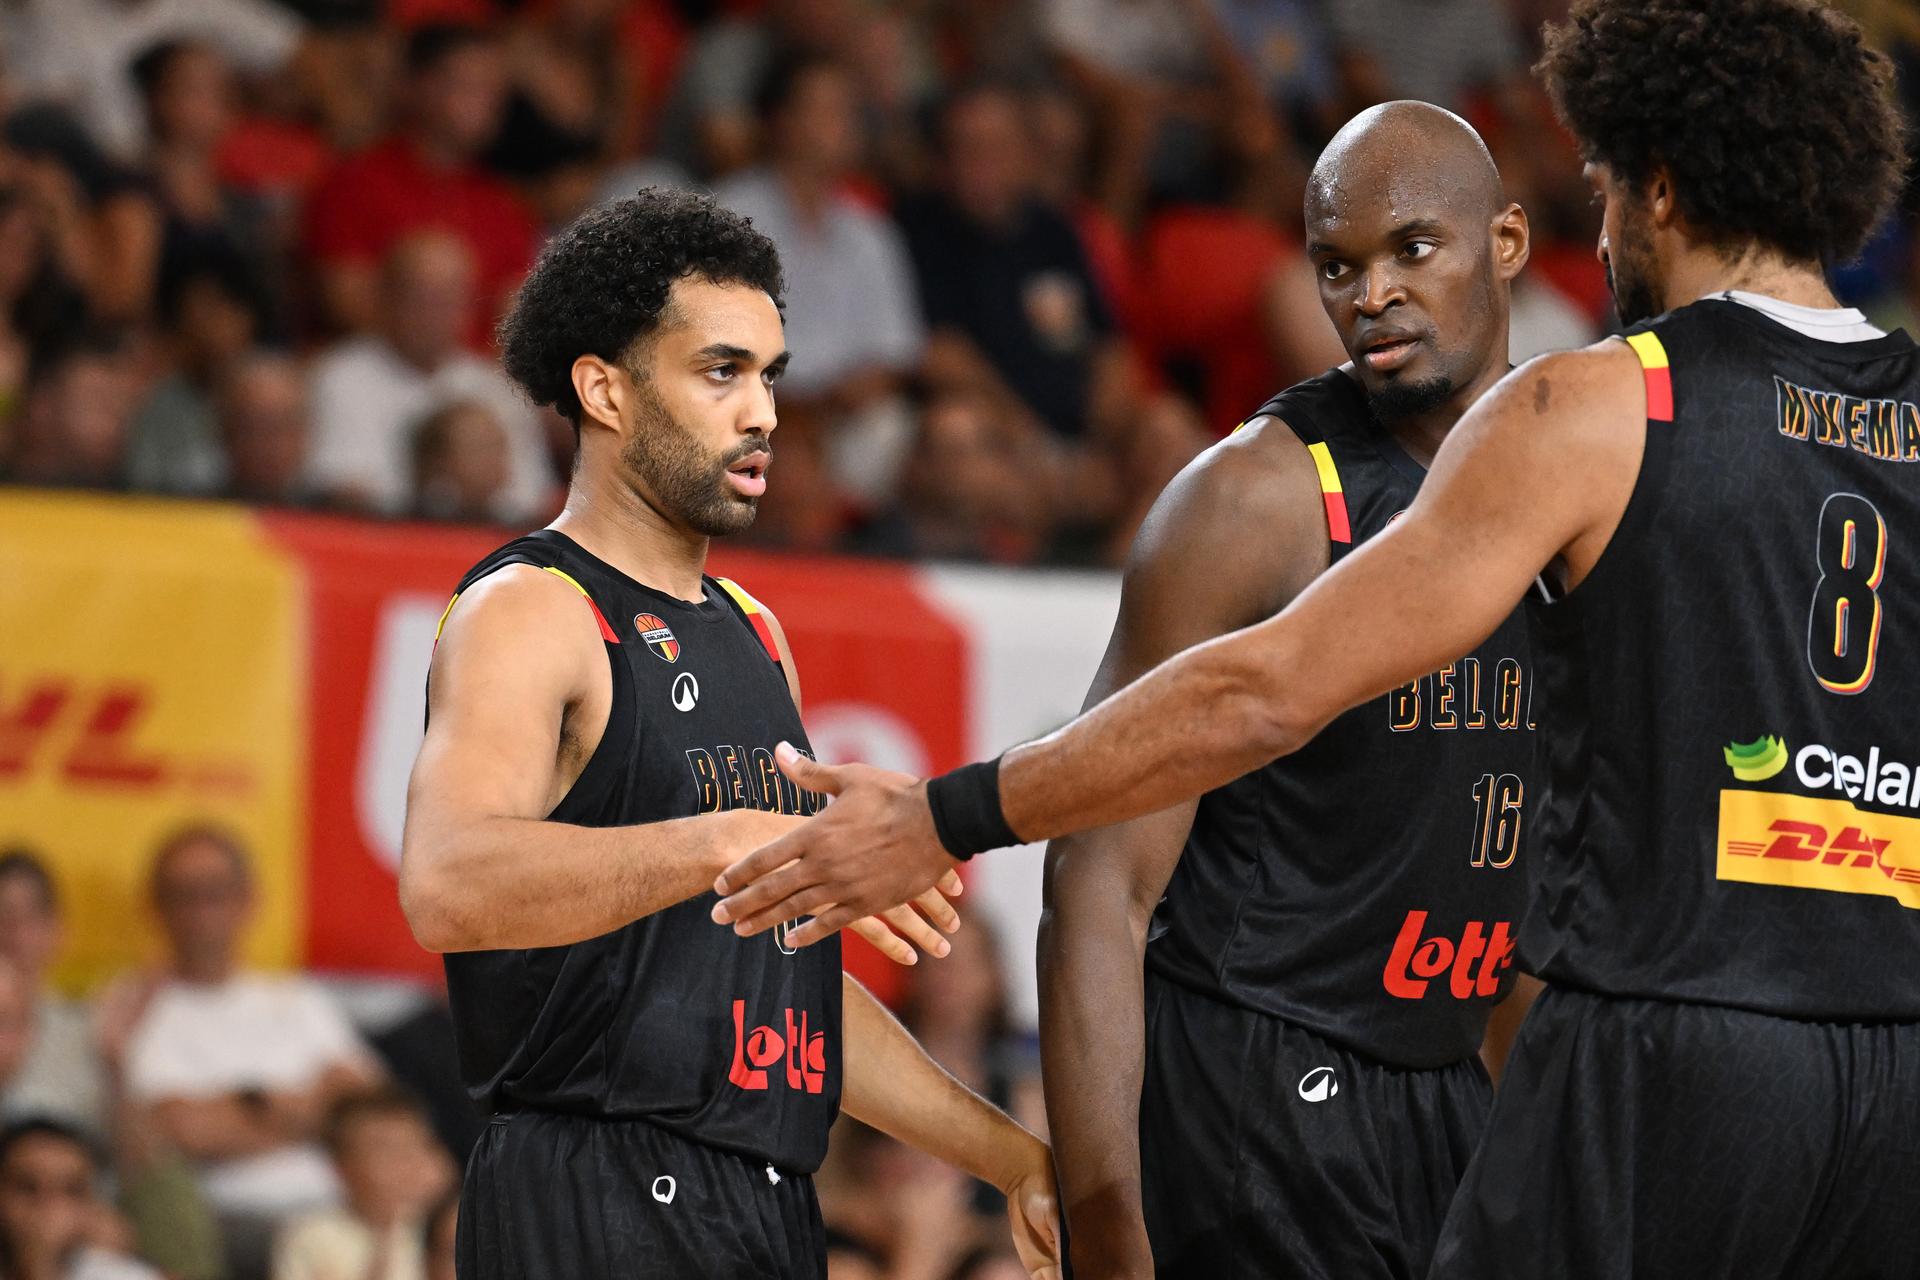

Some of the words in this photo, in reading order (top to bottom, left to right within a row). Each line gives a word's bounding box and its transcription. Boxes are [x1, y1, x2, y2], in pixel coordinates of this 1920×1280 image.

[1808, 492, 1888, 695] 8
[686, 745, 829, 816] BELGI
[1470, 773, 1524, 869] 16
